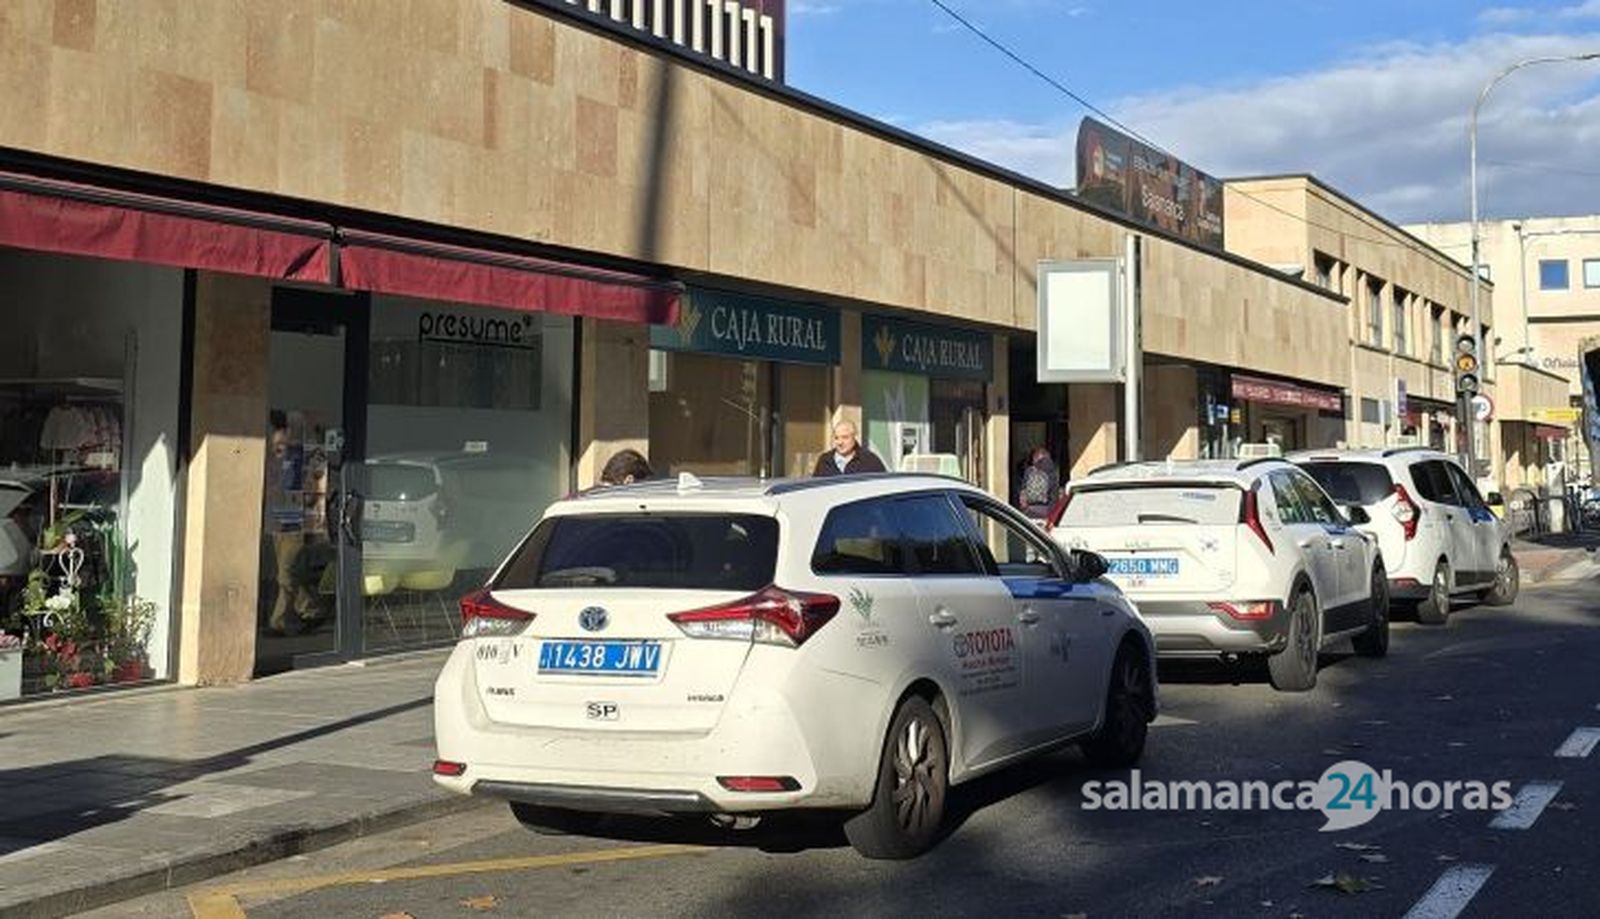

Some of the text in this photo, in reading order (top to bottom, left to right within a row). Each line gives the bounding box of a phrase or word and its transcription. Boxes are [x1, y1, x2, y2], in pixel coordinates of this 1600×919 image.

[419, 311, 522, 343] presume
[711, 306, 826, 350] CAJA RURAL
[902, 334, 983, 370] CAJA RURAL
[966, 627, 1016, 656] TOYOTA
[555, 645, 658, 669] 1438 JWV
[587, 703, 618, 719] SP
